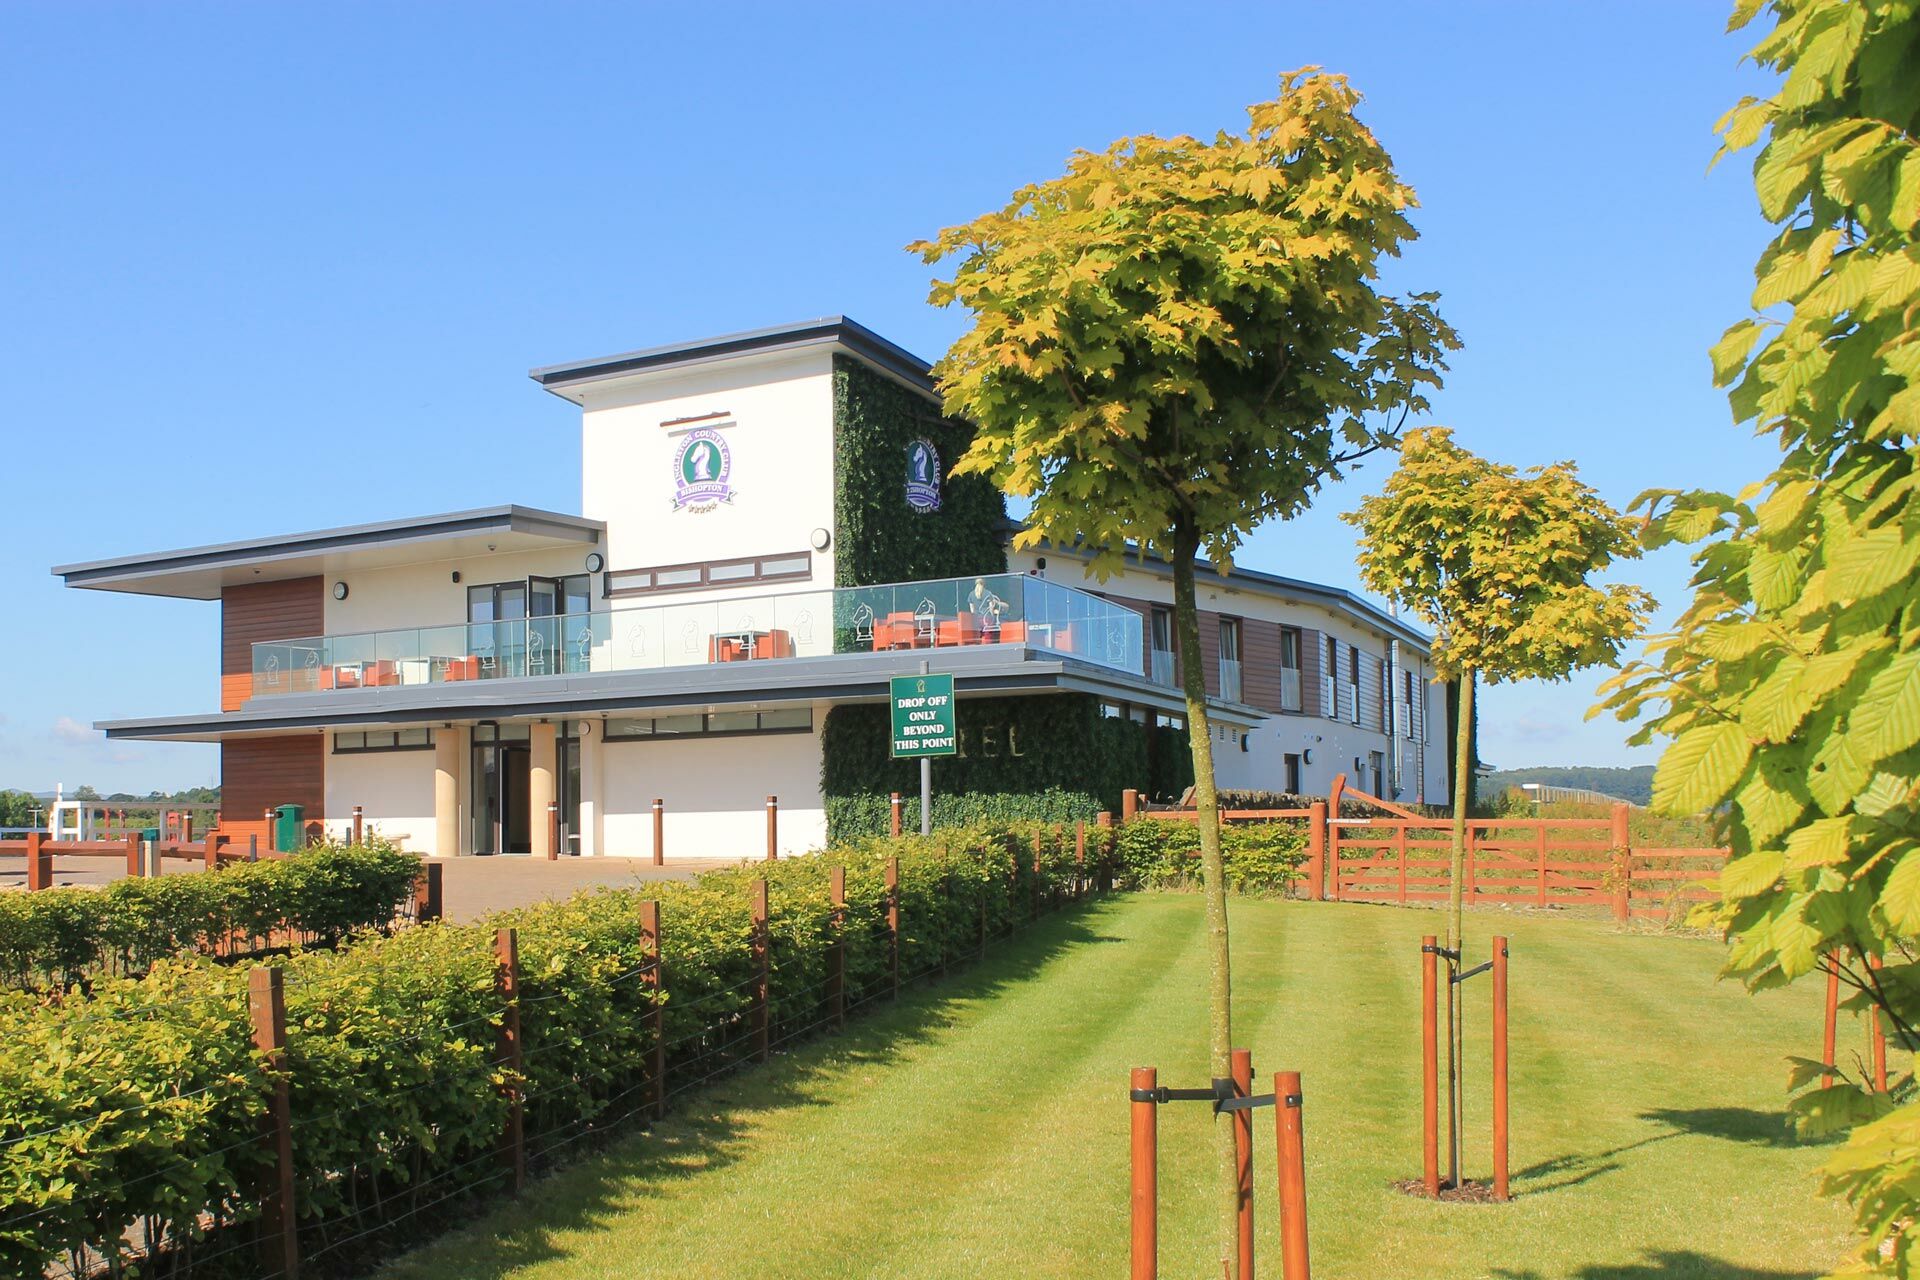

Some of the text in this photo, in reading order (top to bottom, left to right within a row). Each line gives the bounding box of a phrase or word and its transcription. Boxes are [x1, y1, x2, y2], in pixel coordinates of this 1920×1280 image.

[694, 430, 727, 450] COUNTRY
[897, 695, 948, 709] DROP OFF
[909, 710, 937, 722] ONLY
[903, 724, 945, 736] BEYOND
[894, 737, 954, 750] THIS POINT
